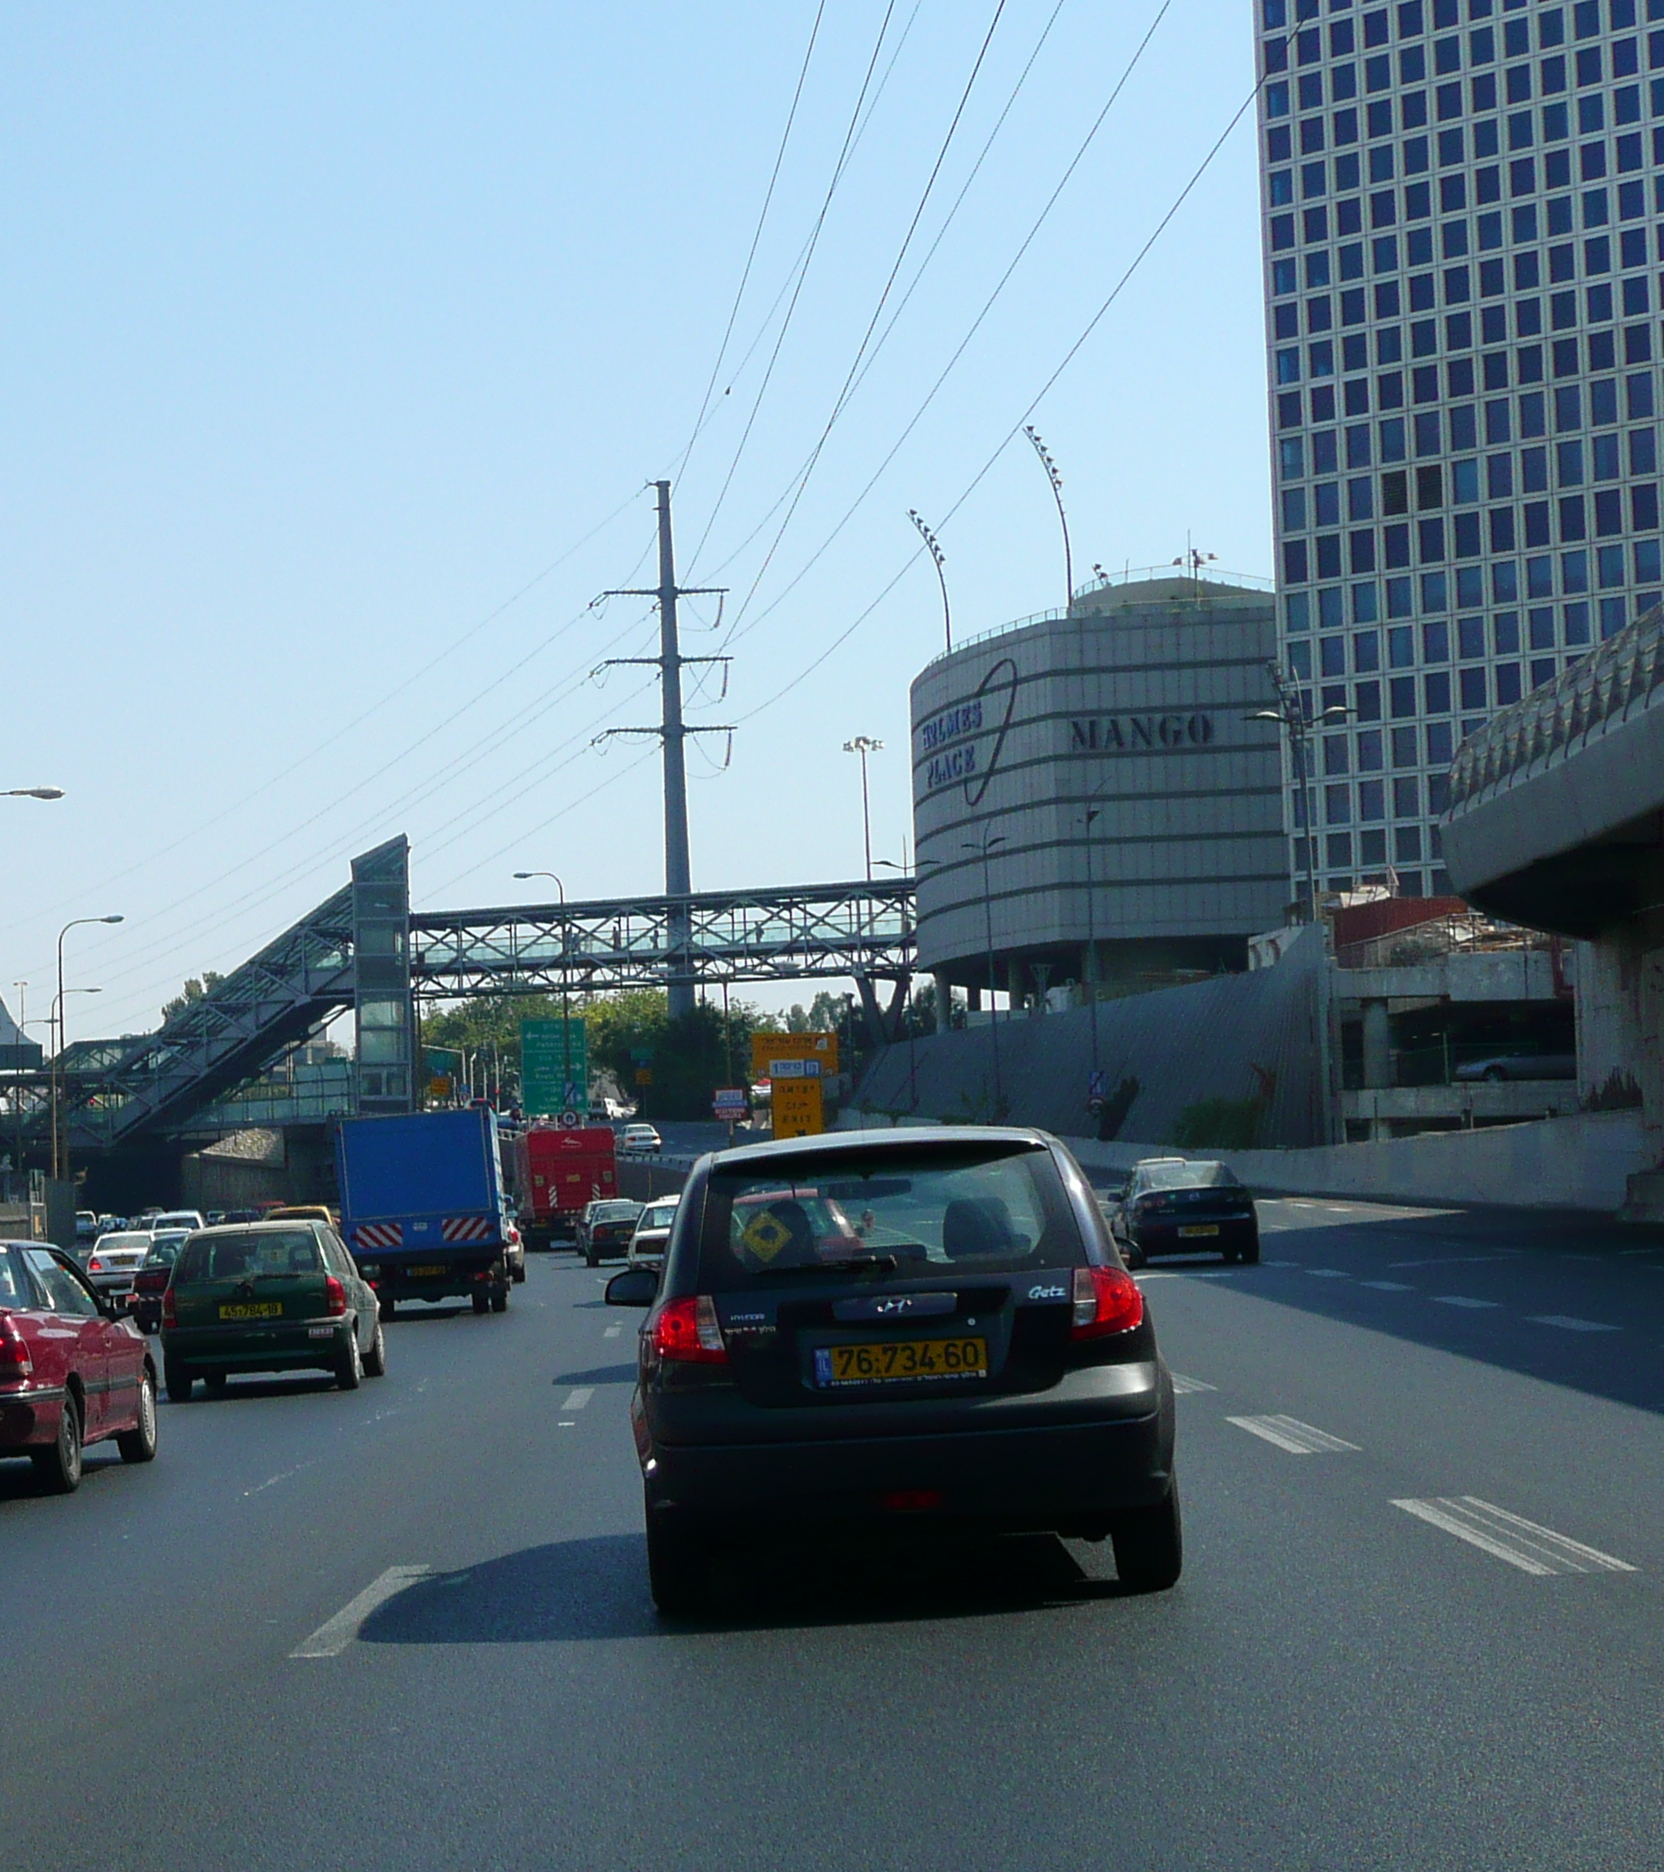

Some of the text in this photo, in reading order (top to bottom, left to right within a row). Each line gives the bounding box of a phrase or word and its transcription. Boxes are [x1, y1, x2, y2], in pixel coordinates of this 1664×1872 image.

[922, 701, 983, 750] HOLMES
[1071, 714, 1214, 750] MANGO
[926, 746, 976, 789] PLACE
[1028, 1285, 1067, 1300] Getz
